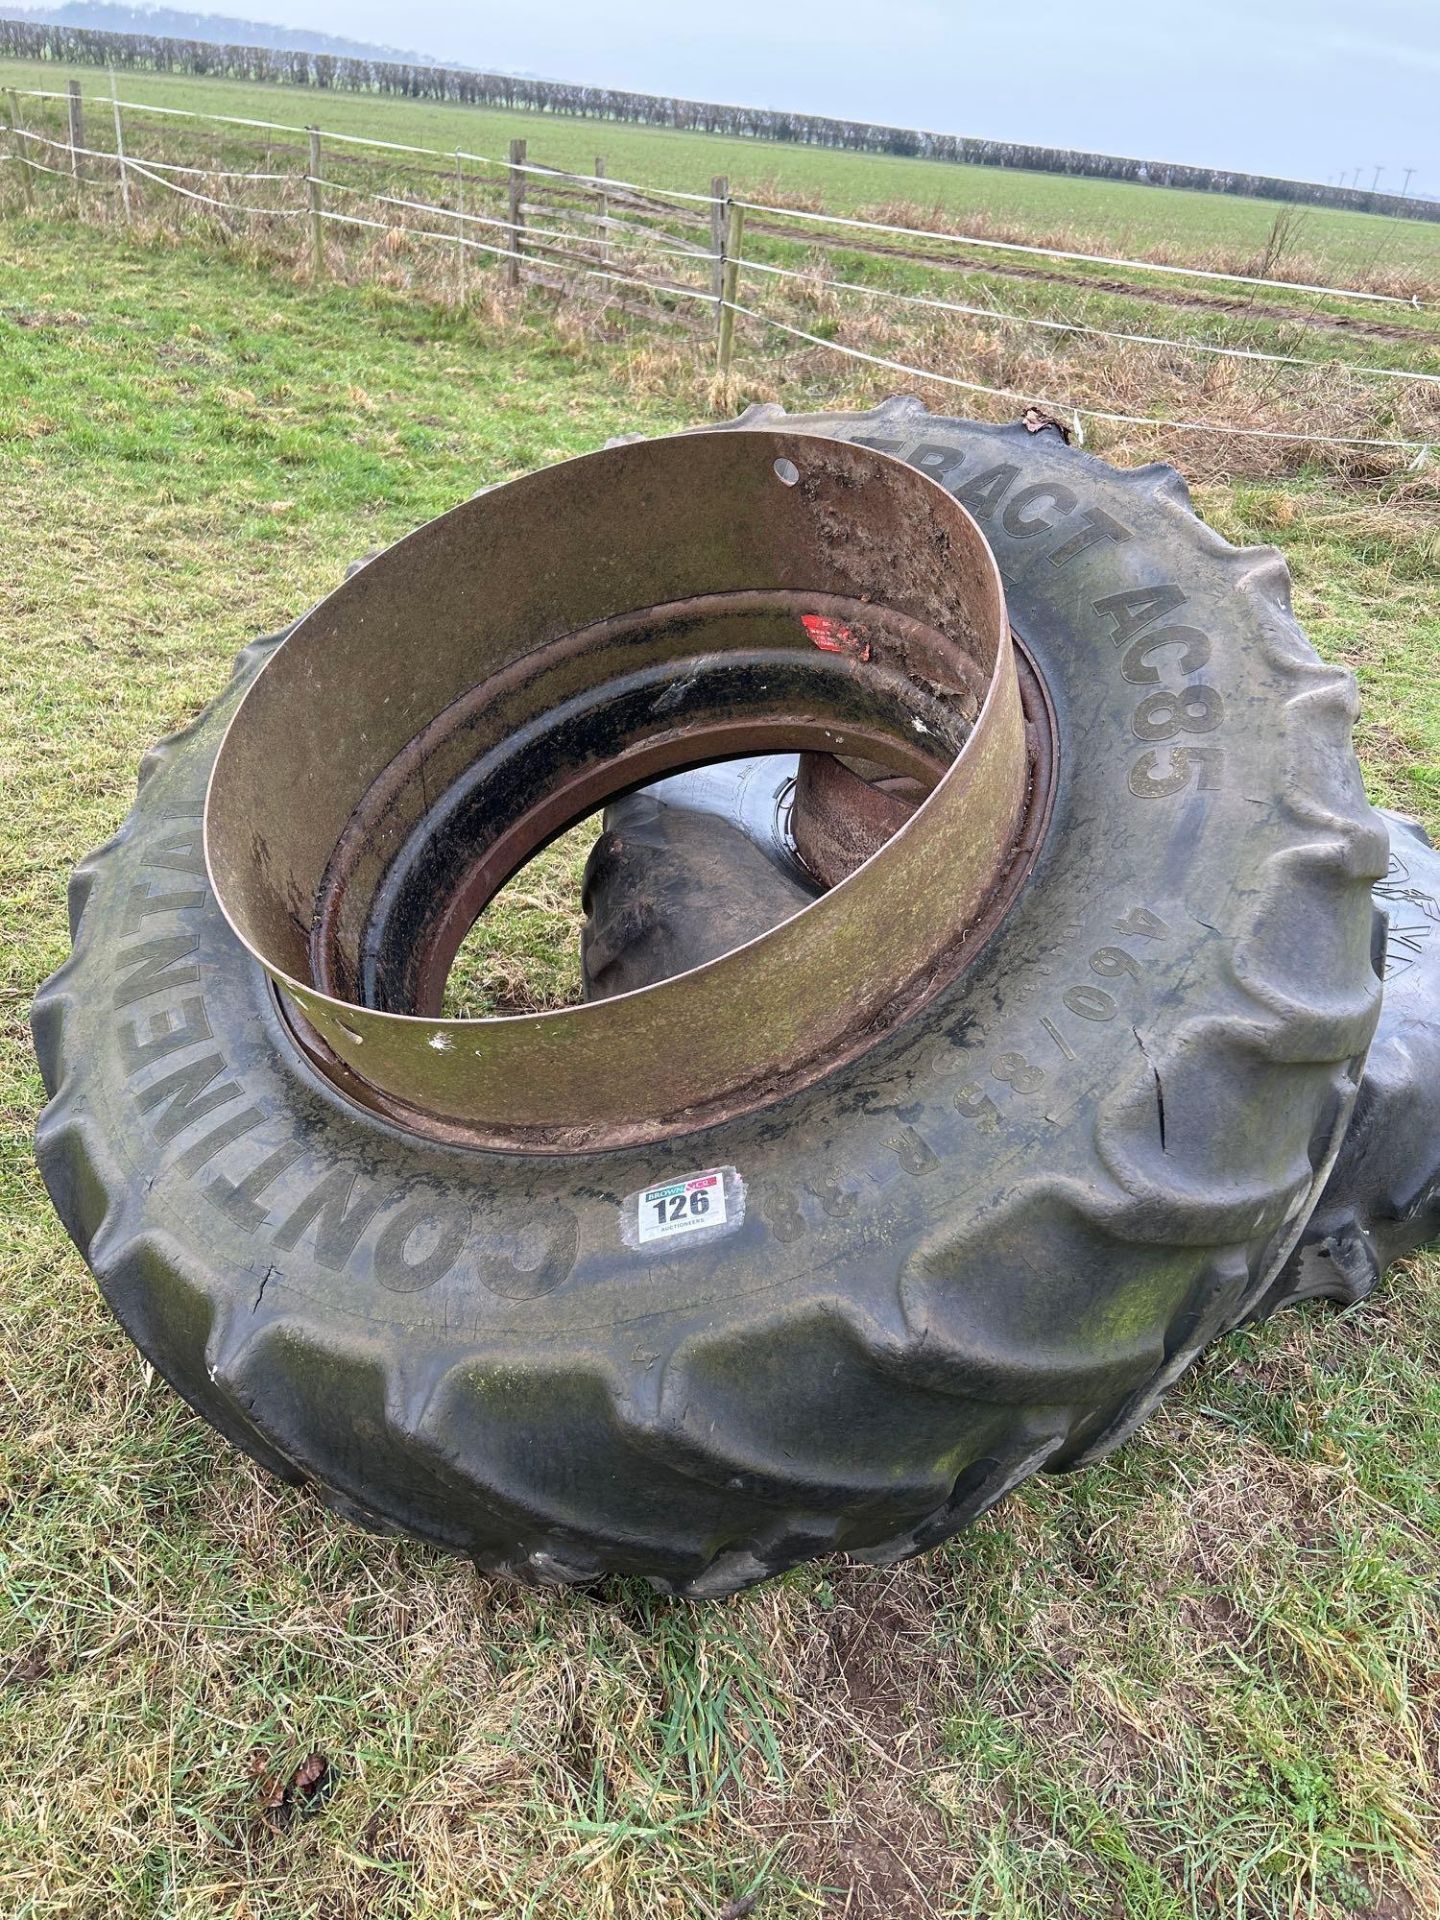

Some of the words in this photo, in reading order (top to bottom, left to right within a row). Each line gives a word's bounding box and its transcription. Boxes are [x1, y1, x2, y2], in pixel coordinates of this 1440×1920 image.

[1091, 584, 1225, 798] AC85
[653, 1189, 709, 1224] 126
[661, 1218, 705, 1232] AUCTIONEERS
